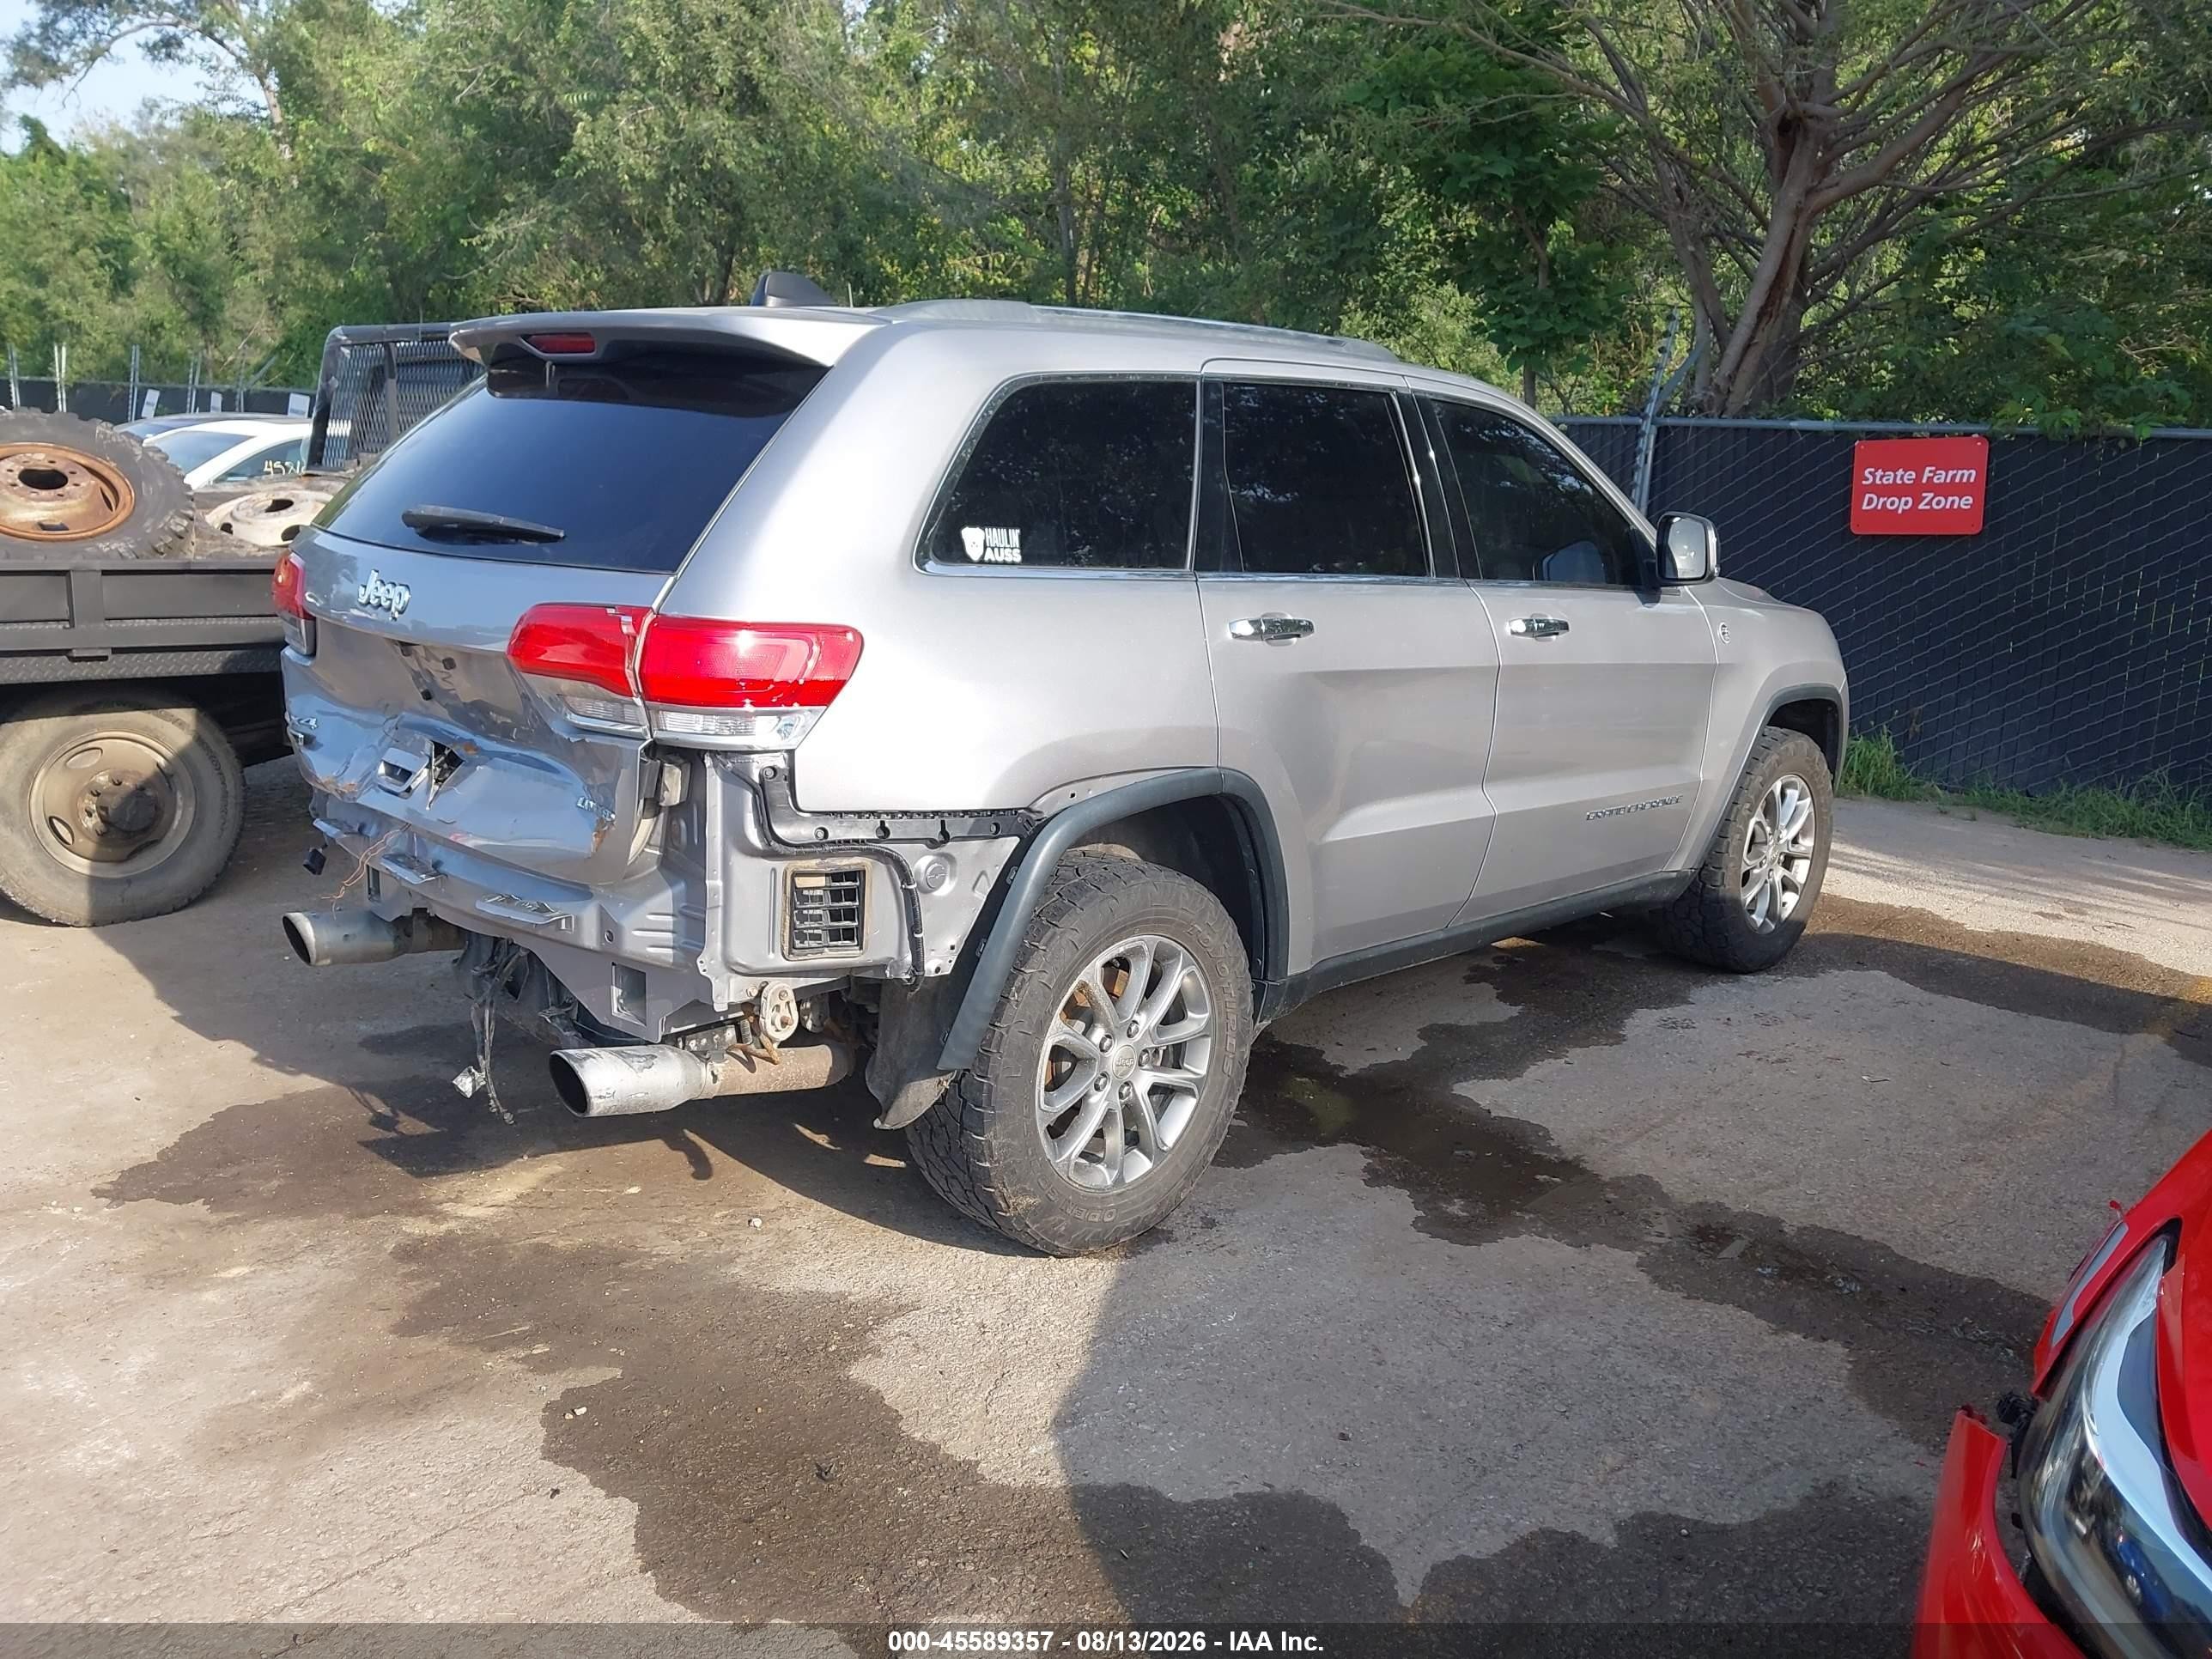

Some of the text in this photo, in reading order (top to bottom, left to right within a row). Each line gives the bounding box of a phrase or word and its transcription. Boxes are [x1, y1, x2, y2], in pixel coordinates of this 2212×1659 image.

[1862, 466, 1977, 485] State Farm
[1862, 492, 1973, 514] Drop Zone
[984, 547, 1022, 562] AUSS
[357, 568, 411, 622] Jeep
